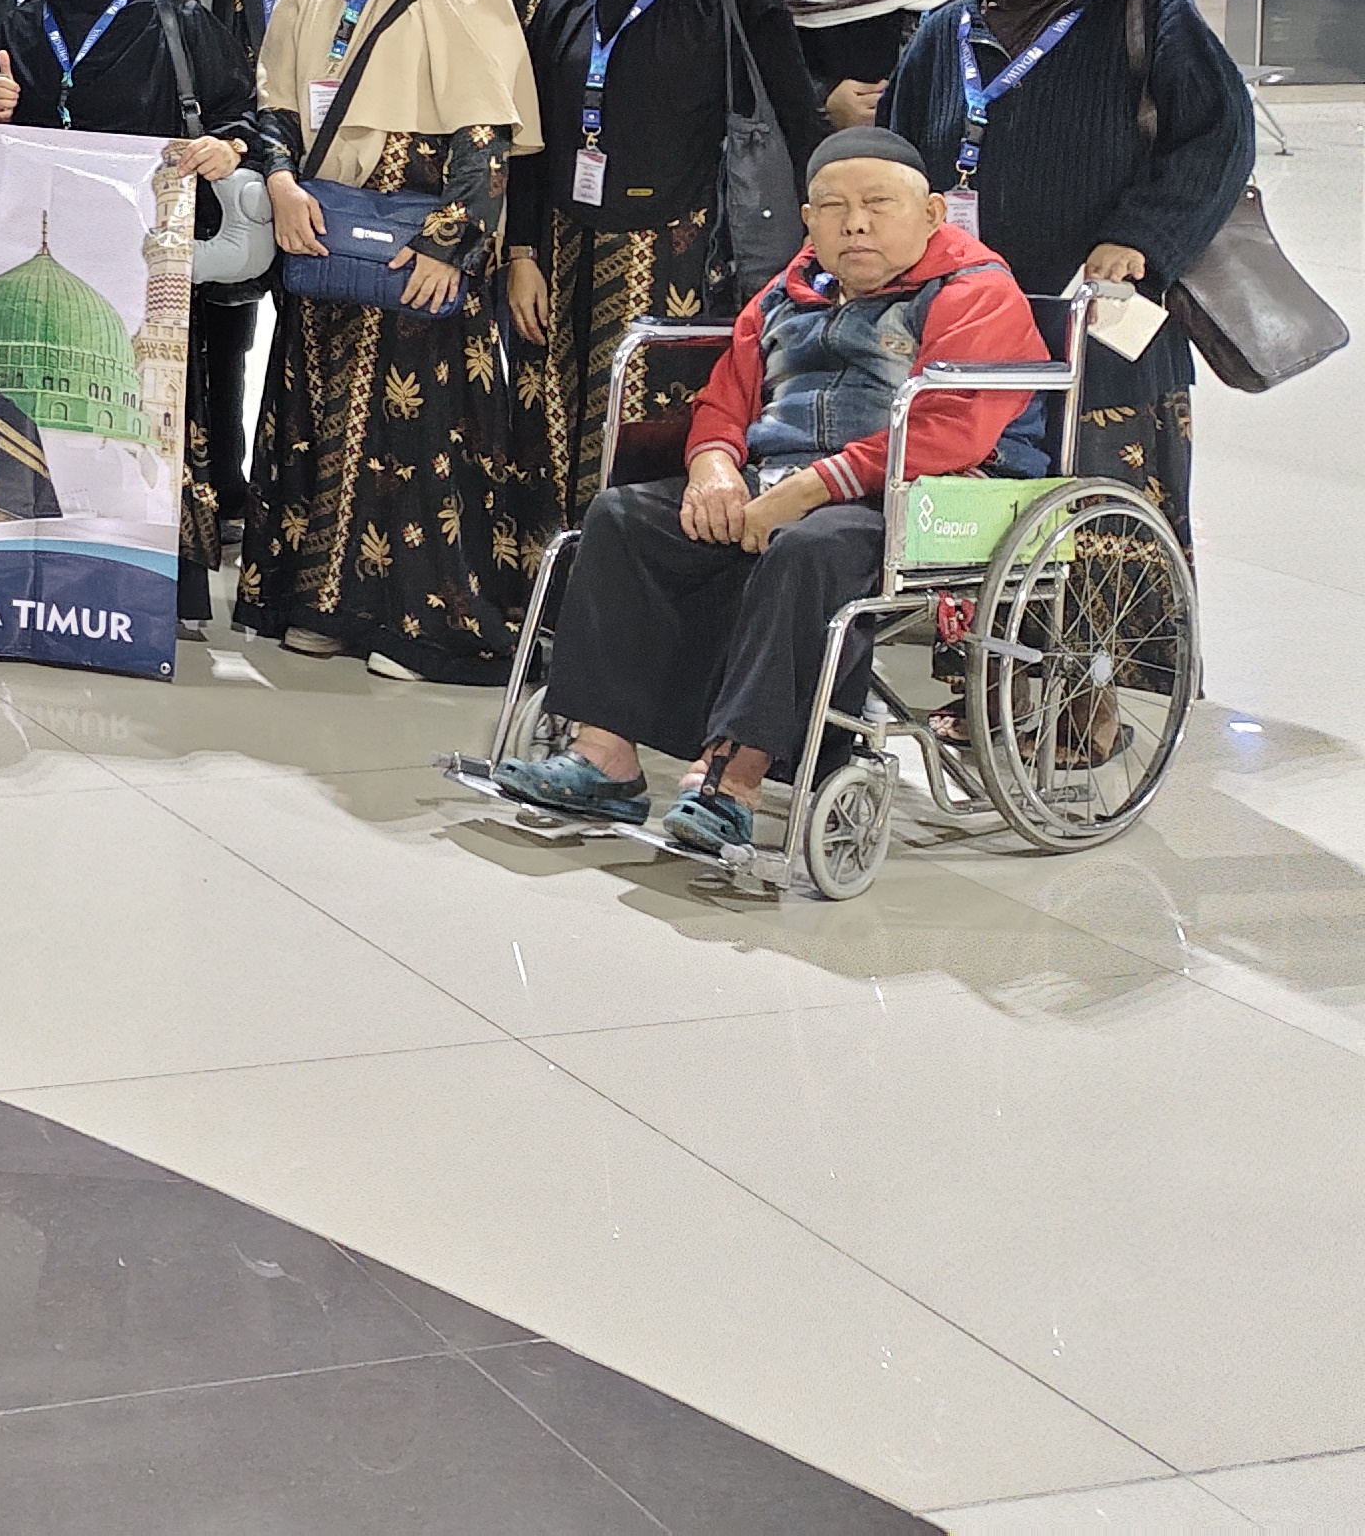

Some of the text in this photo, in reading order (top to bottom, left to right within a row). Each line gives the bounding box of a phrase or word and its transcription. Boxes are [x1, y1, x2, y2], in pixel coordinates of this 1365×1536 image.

[1000, 55, 1032, 86] DALWA
[933, 517, 979, 537] Gapura
[12, 597, 135, 644] TIMUR
